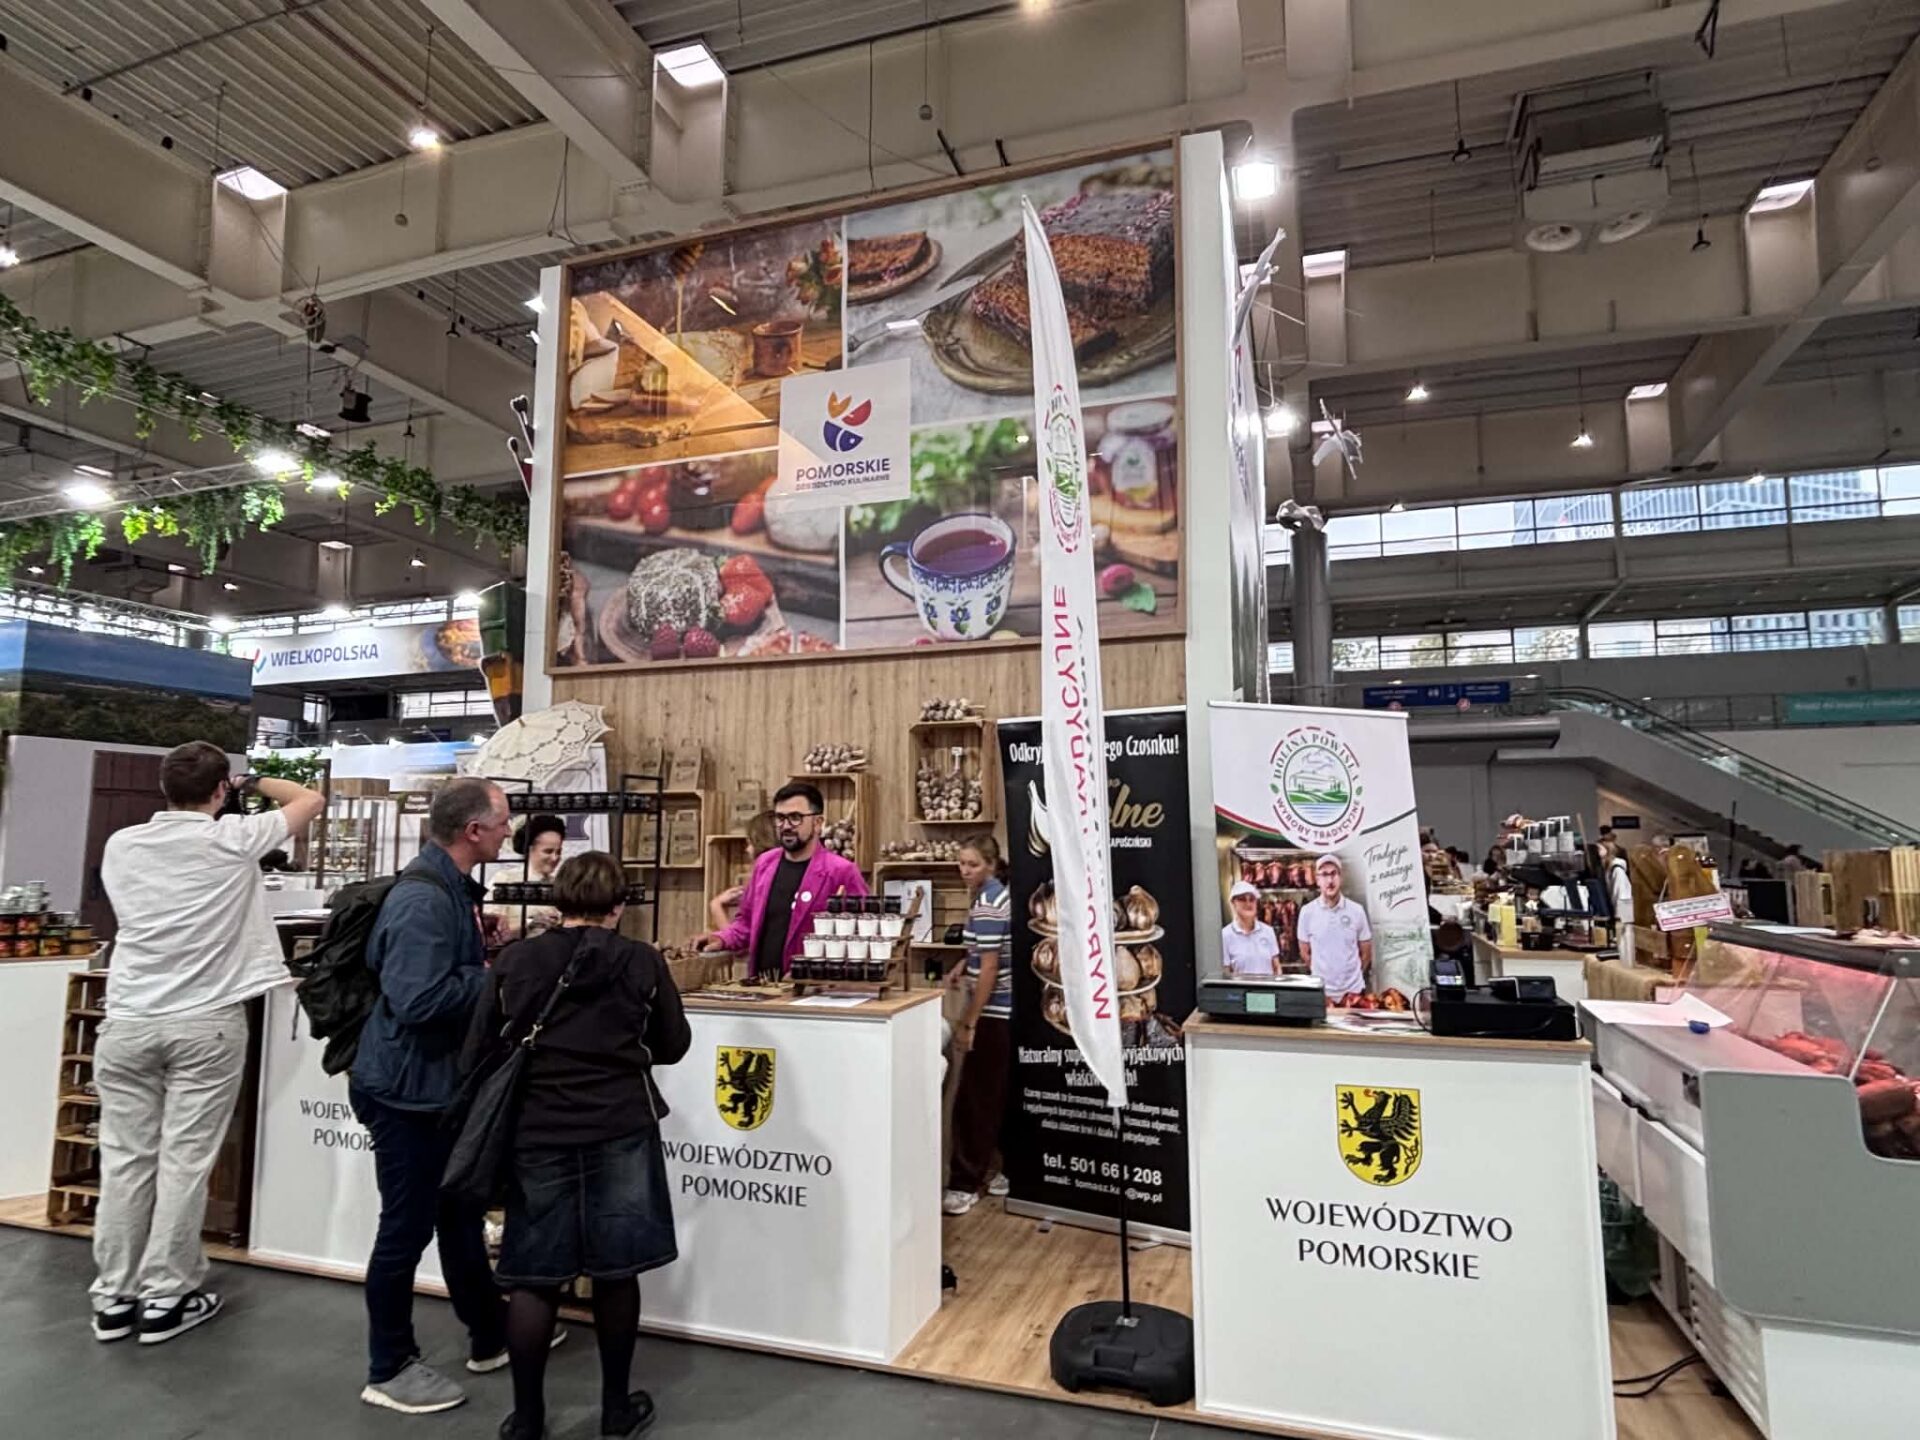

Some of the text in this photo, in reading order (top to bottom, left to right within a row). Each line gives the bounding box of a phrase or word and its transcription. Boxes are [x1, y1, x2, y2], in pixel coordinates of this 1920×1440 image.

[796, 458, 891, 481] POMORSKIE
[270, 644, 379, 667] WIELKOPOLSKA
[1126, 734, 1180, 756] Czosnku!
[1273, 734, 1308, 779] DOLINA
[1277, 797, 1360, 838] WYROBY TRADYCYJNE
[1363, 843, 1408, 867] Tradycja
[1370, 875, 1377, 883] z
[1018, 1046, 1062, 1067] Naturalny
[314, 1128, 375, 1151] POMOR
[662, 1141, 832, 1177] WOJEWÓDZTWO
[1043, 1153, 1066, 1170] tel.
[1070, 1156, 1096, 1175] 501
[1133, 1167, 1163, 1186] 208
[682, 1174, 808, 1208] POMORSKIE
[1266, 1197, 1513, 1243] WOJEWÓDZTWO
[1298, 1238, 1481, 1280] POMORSKIE
